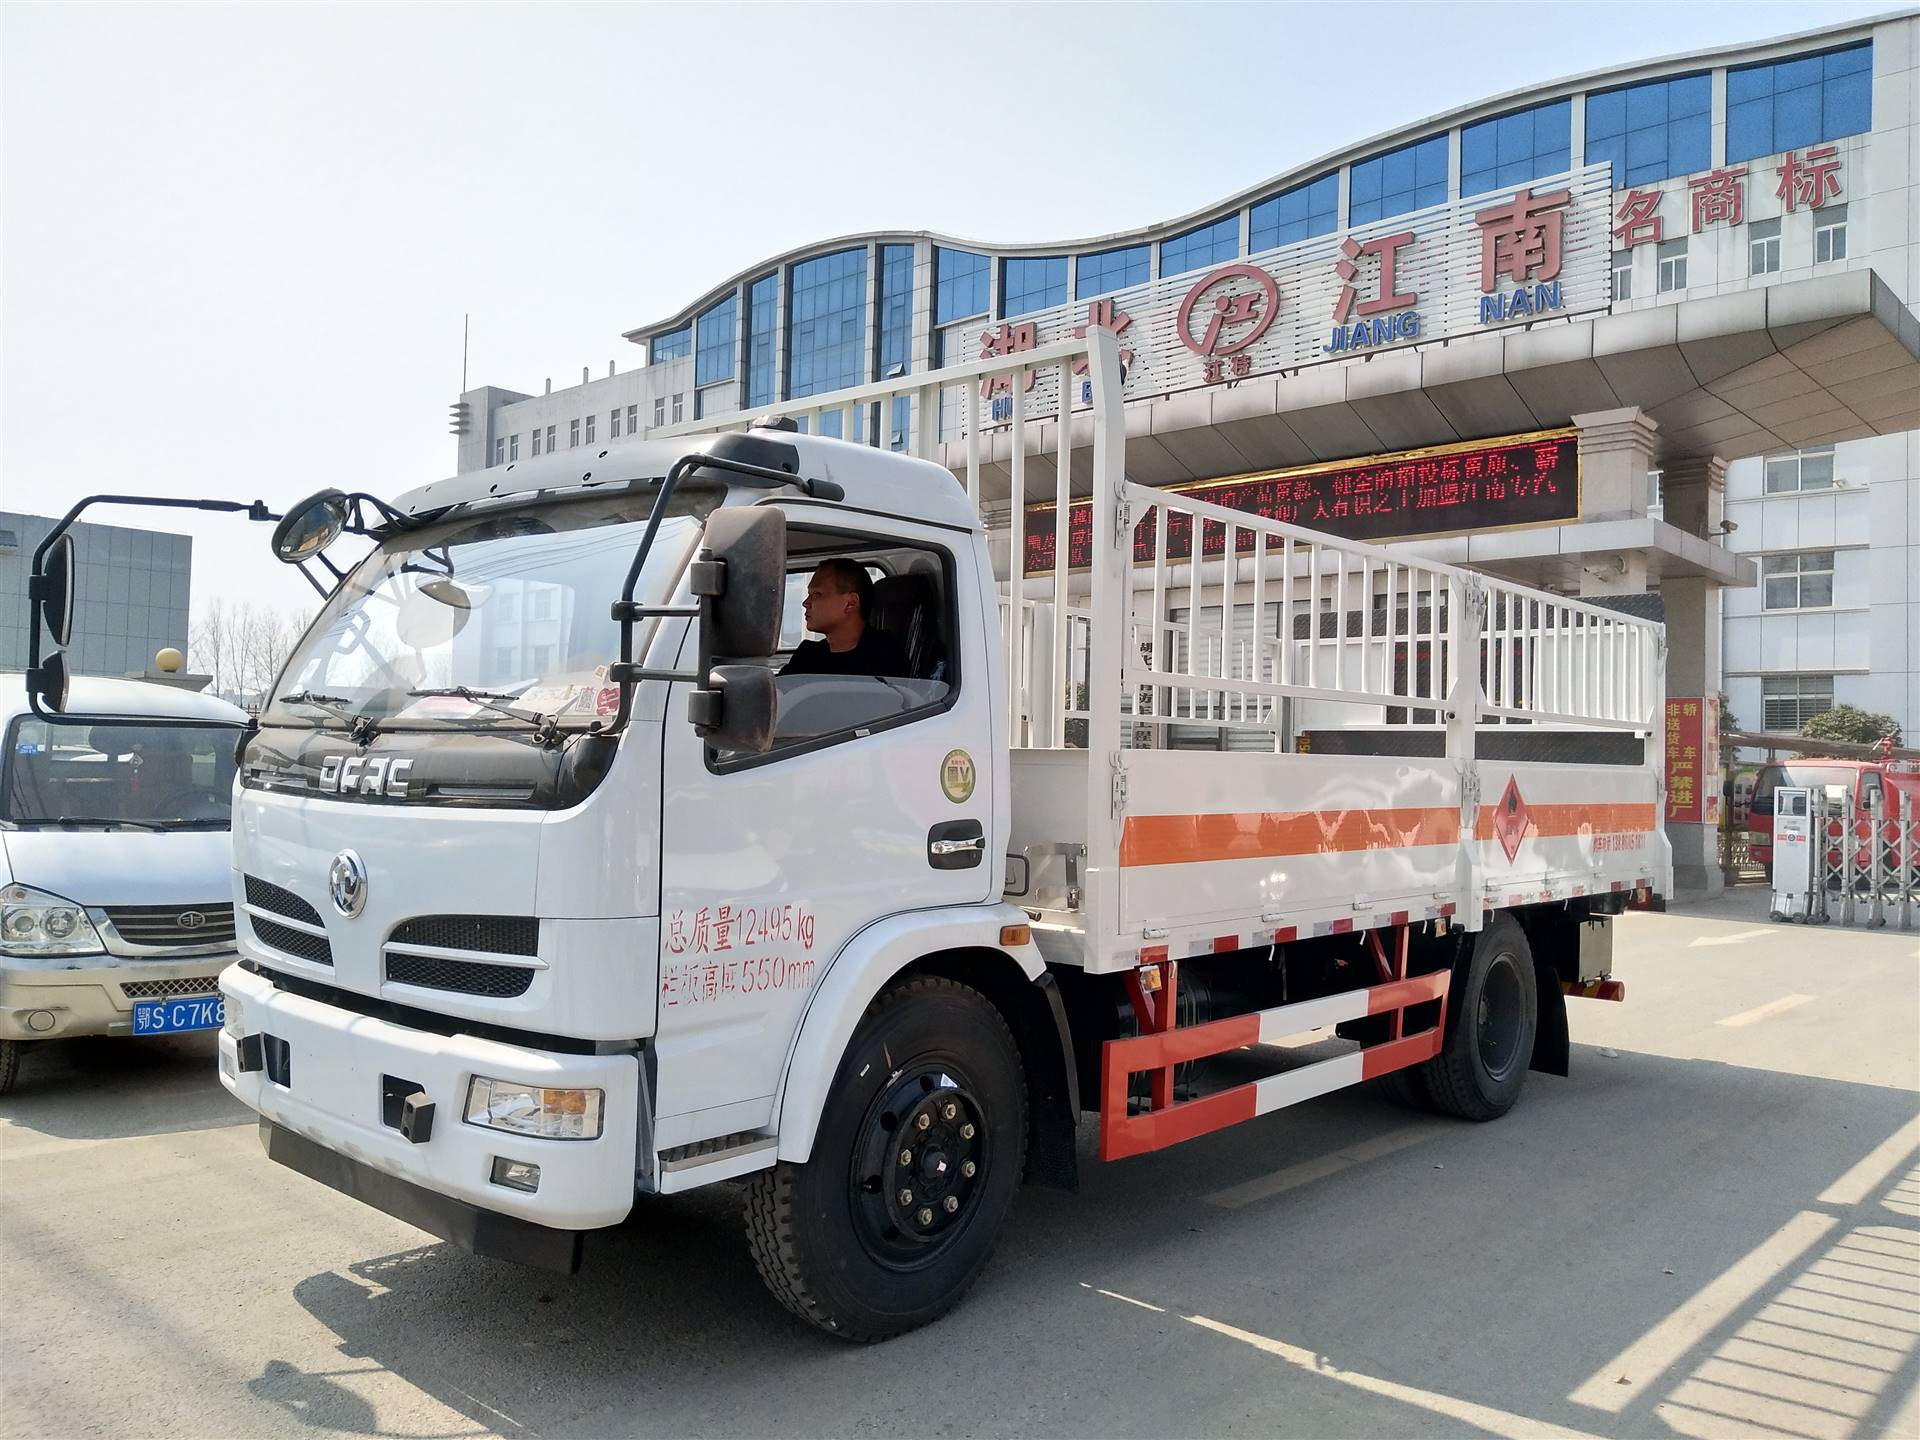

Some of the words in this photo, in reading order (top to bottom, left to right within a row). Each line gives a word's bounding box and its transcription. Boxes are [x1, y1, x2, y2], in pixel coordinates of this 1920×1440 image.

[1332, 188, 1570, 326] 江南
[1323, 310, 1421, 353] JIANG
[1479, 280, 1562, 325] NAN
